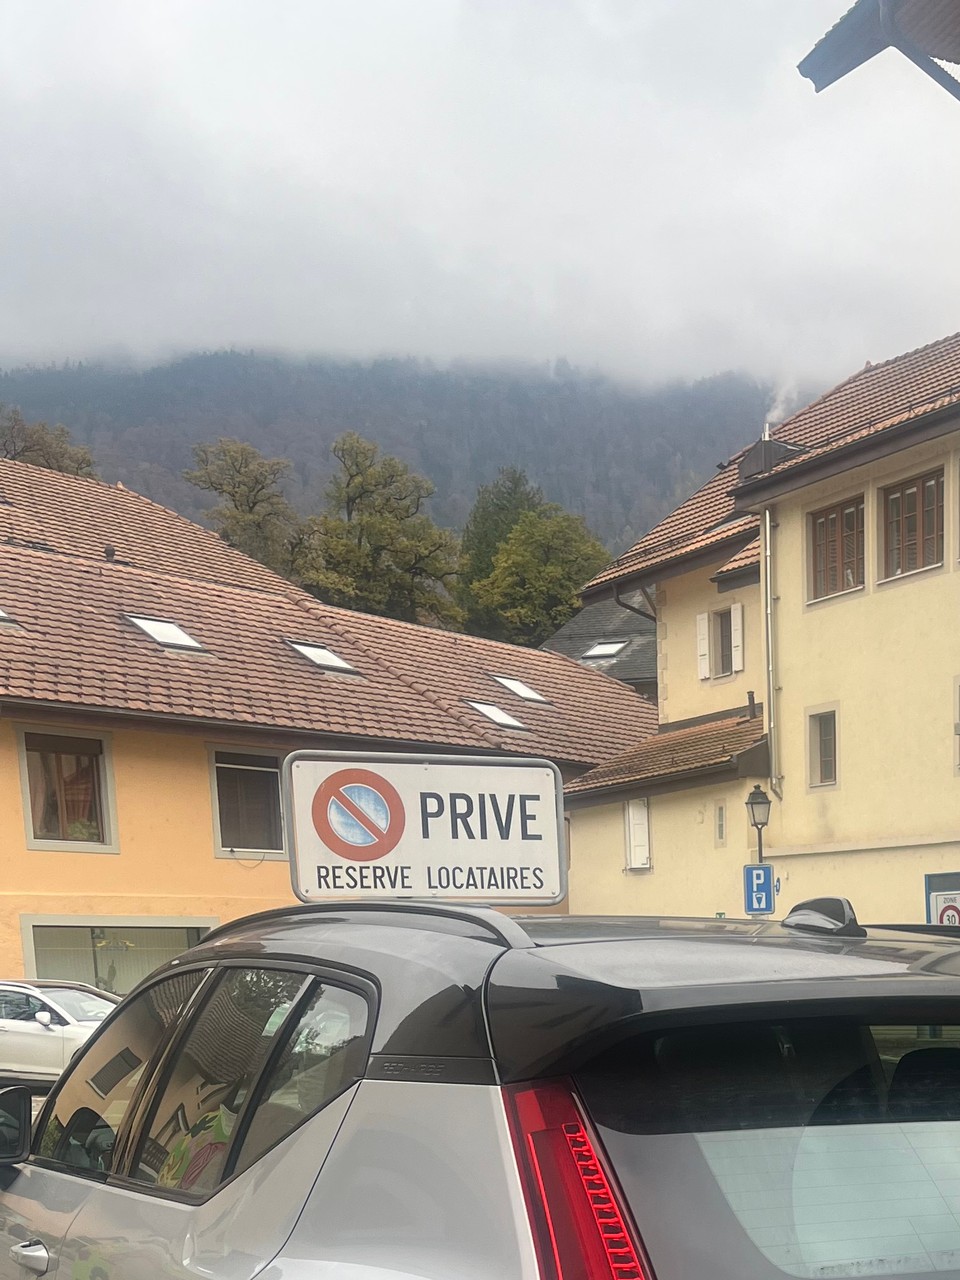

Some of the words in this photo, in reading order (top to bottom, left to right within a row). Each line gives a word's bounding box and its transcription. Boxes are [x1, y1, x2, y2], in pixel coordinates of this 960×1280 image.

[419, 791, 543, 841] PRIVE
[316, 865, 413, 889] RESERVE
[427, 866, 545, 890] LOCATAIRES
[752, 869, 765, 892] P
[943, 896, 958, 904] ZONE
[946, 914, 957, 925] 30
